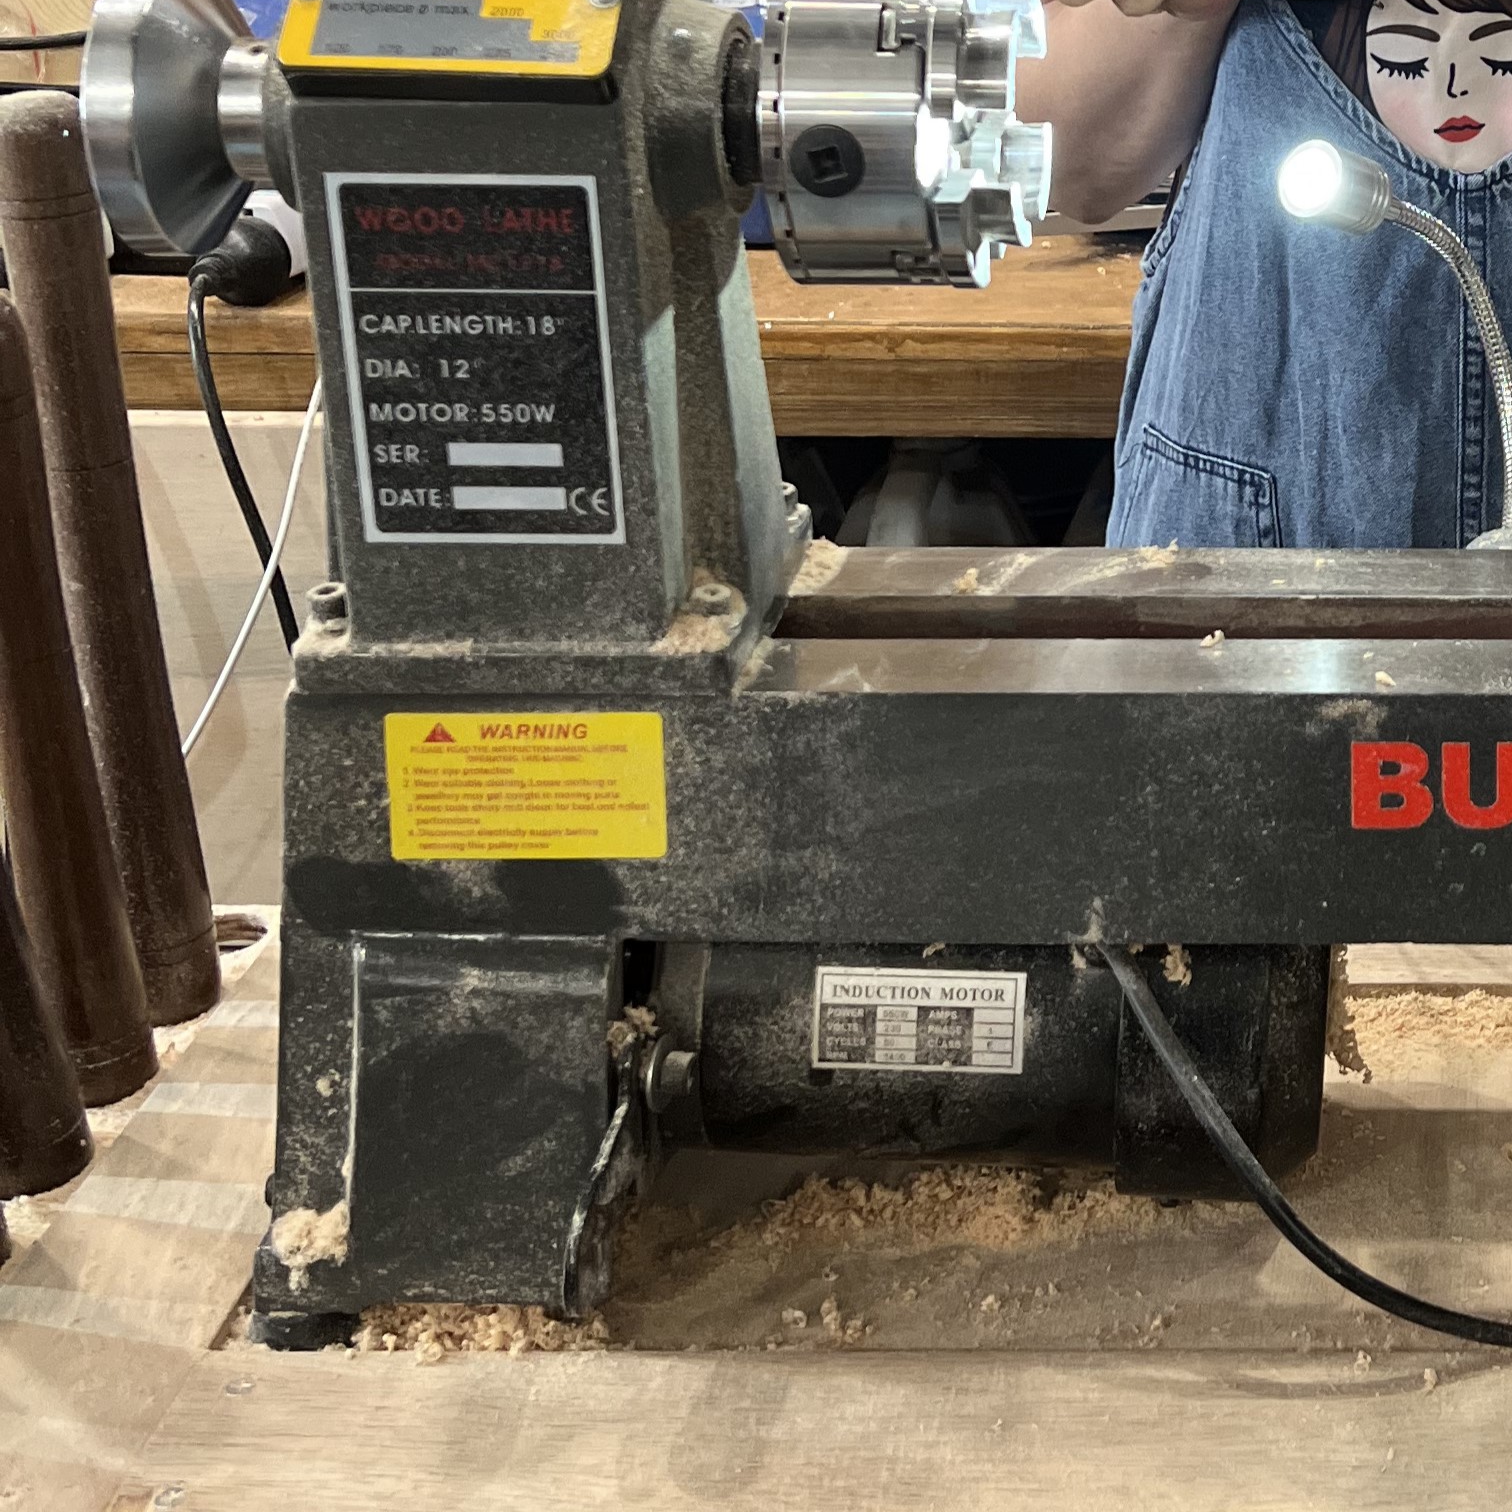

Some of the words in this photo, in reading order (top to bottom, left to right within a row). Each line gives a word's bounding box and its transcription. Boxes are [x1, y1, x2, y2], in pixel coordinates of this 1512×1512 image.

[355, 206, 464, 234] WOOD
[482, 206, 574, 234] LATHE
[479, 723, 589, 740] WARNING
[832, 983, 931, 1000] INDUCTION
[940, 987, 1006, 1003] MOTOR
